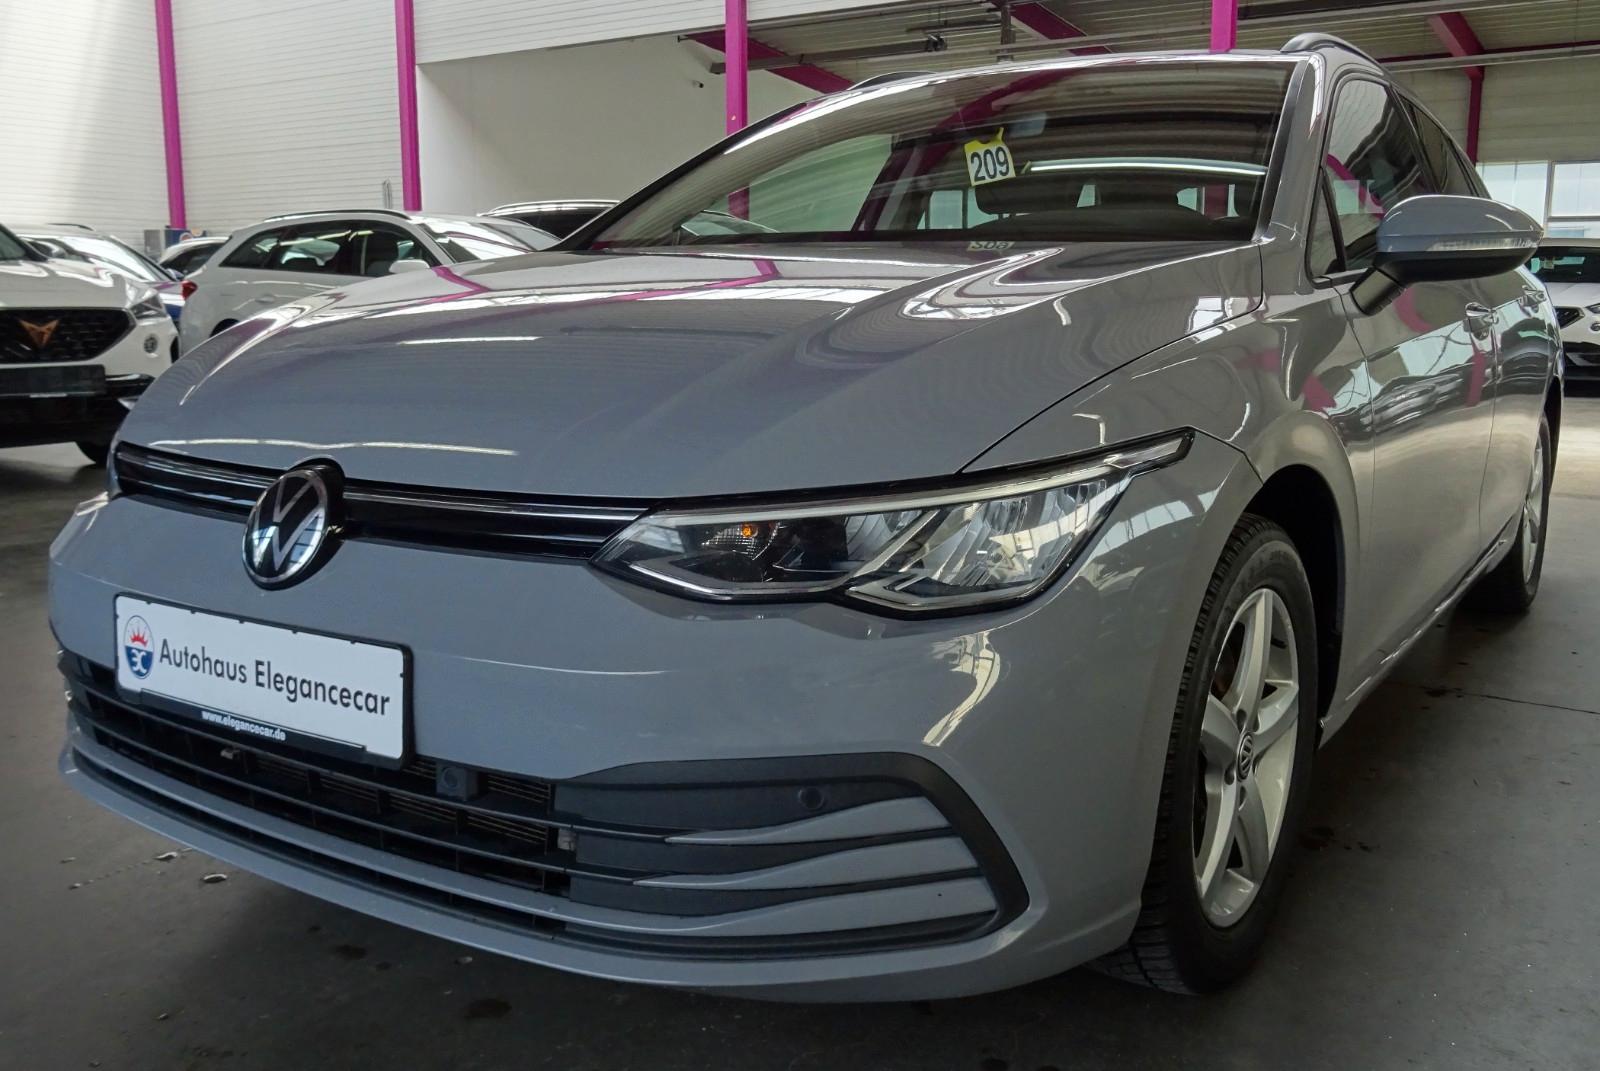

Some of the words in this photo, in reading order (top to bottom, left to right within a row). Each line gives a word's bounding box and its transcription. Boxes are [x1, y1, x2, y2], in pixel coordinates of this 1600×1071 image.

[970, 146, 1010, 181] 209
[159, 638, 247, 684] Autohaus
[255, 659, 391, 716] Elegancecar
[200, 710, 287, 741] www.elegancecar.de
